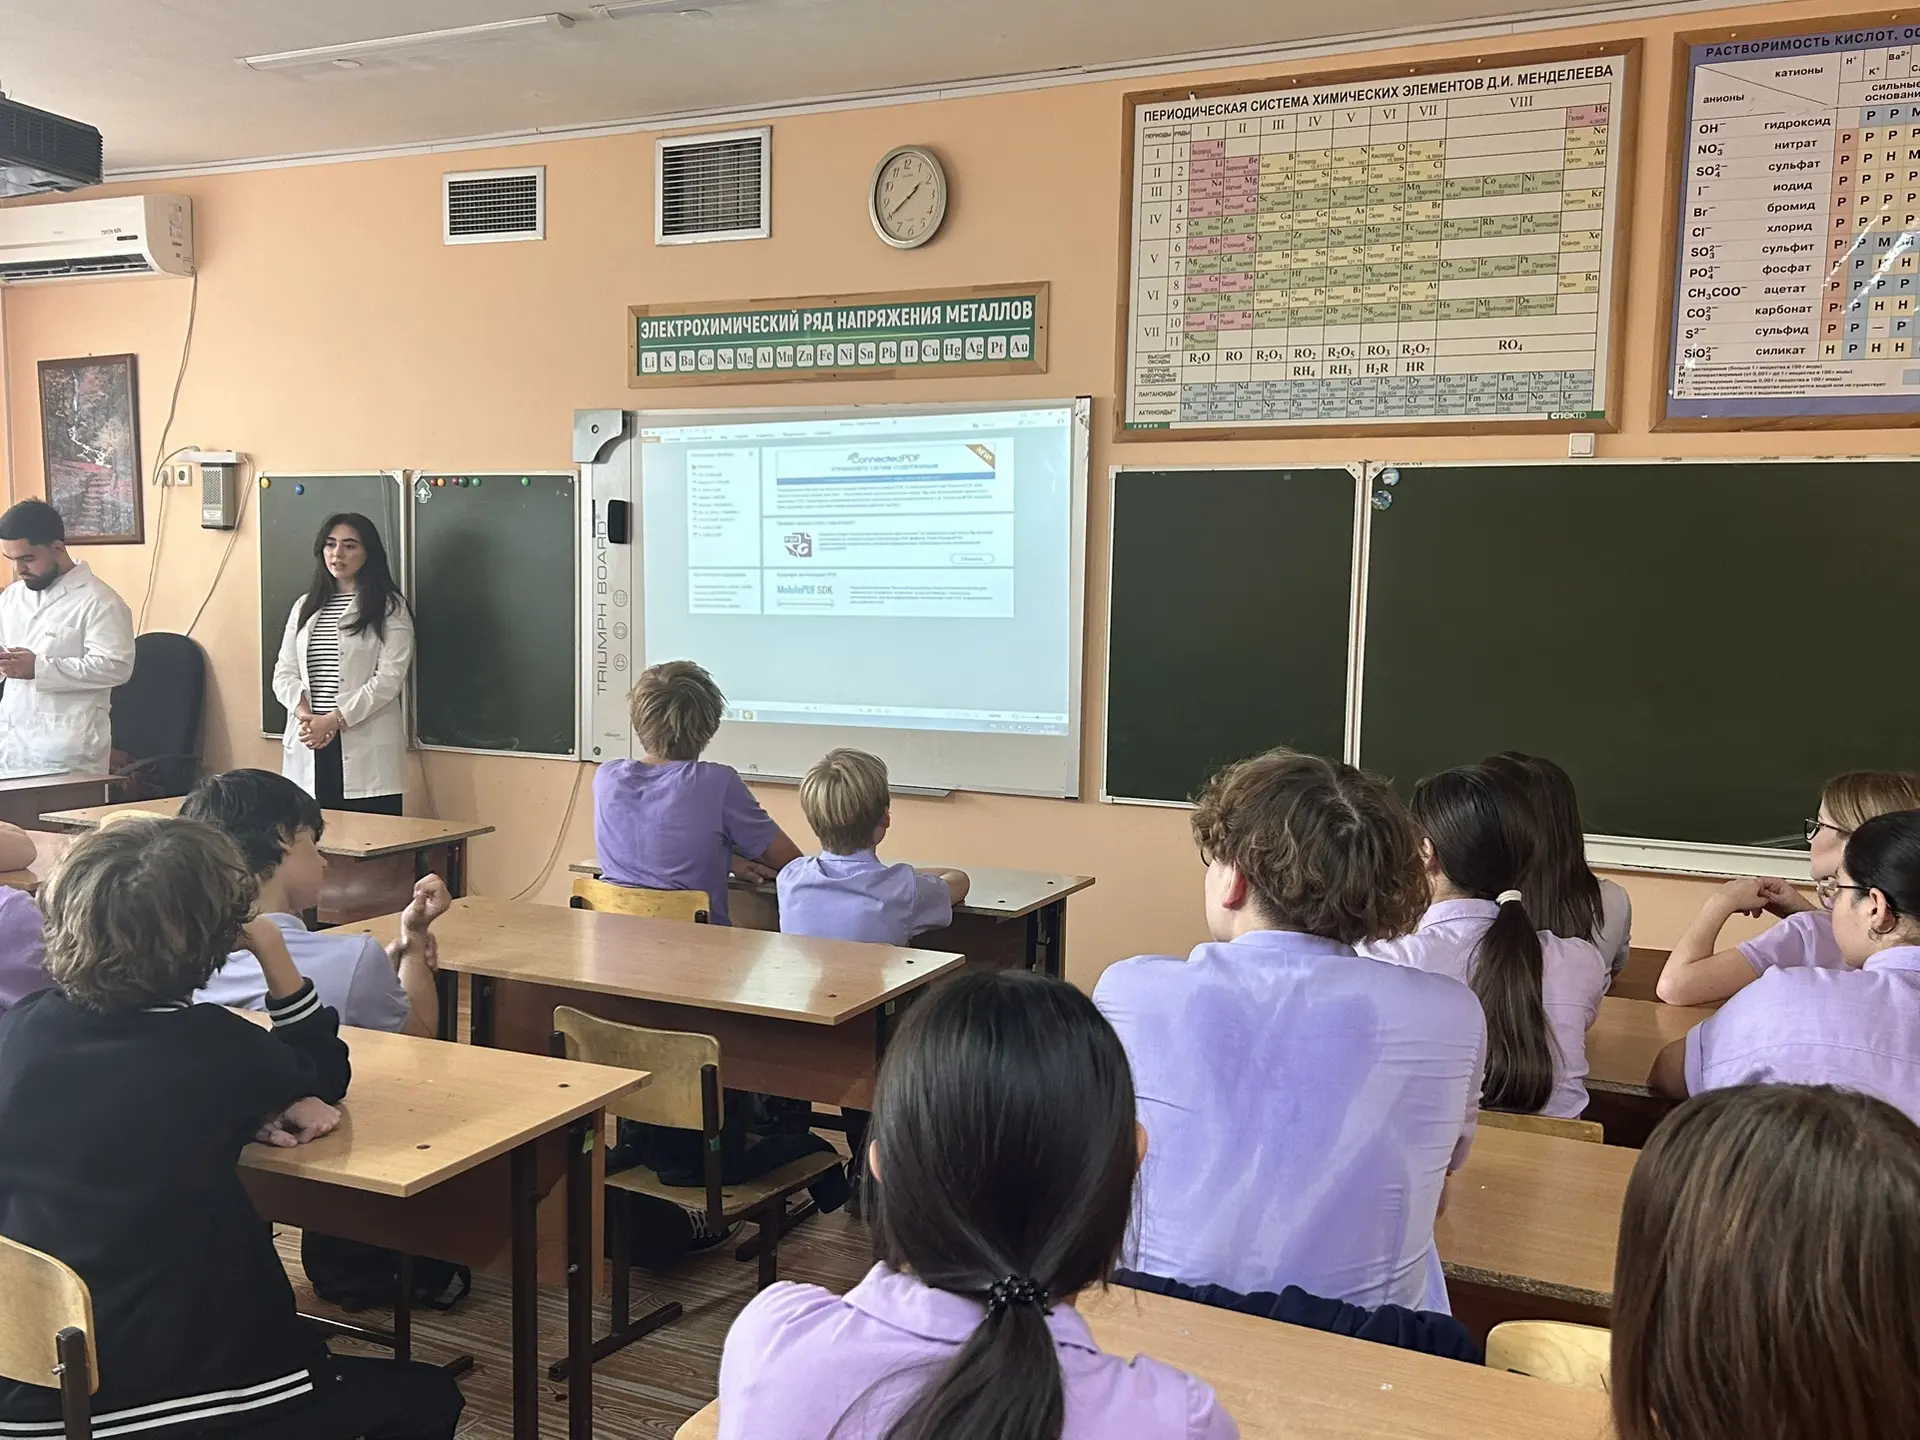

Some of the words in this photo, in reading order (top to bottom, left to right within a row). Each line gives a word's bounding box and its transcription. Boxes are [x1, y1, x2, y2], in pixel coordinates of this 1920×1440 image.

[1706, 37, 1830, 58] РАСТВОРИМОСТЬ
[1835, 29, 1897, 46] КИСЛОТ,
[1775, 66, 1823, 78] катионы
[1144, 101, 1247, 122] ПЕРИОДИЧЕСКАЯ
[1251, 95, 1309, 112] СИСТЕМА
[1312, 86, 1399, 106] ХИМИЧЕСКИХ
[1403, 77, 1484, 97] ЭЛЕМЕНТОВ
[1486, 75, 1513, 90] Д.И.
[1517, 64, 1613, 86] МЕНДЕЛЕЕВА
[1703, 93, 1744, 104] анионы
[1239, 123, 1247, 134] II
[1272, 120, 1285, 130] III
[1309, 116, 1322, 127] IV
[1347, 113, 1356, 123] V
[1383, 109, 1396, 119] VI
[1419, 105, 1437, 116] VII
[1509, 96, 1533, 108] VIII
[1764, 117, 1831, 132] гидроксид
[1774, 139, 1817, 150] нитрат
[1180, 147, 1183, 156] 1
[904, 159, 911, 170] 12
[918, 163, 922, 173] 1
[1768, 159, 1820, 173] сульфат
[892, 167, 899, 178] 11
[1154, 167, 1161, 177] II
[1177, 167, 1183, 176] 2
[926, 174, 932, 185] 2
[885, 182, 893, 192] 10
[1151, 186, 1162, 196] III
[1177, 185, 1183, 195] 3
[1773, 180, 1812, 193] иодид
[931, 190, 935, 199] 3
[884, 198, 890, 209] 9
[1767, 200, 1815, 213] бромид
[927, 205, 933, 215] 4
[1176, 204, 1182, 214] 4
[920, 218, 925, 228] 5
[1150, 214, 1162, 224] IV
[897, 222, 903, 232] 7
[908, 225, 914, 236] 6
[1175, 223, 1181, 233] 5
[1767, 223, 1812, 234] хлорид
[1174, 243, 1181, 252] 6
[1762, 242, 1814, 255] сульфит
[1150, 254, 1159, 263] V
[1174, 262, 1180, 271] 7
[1762, 263, 1811, 276] фосфат
[1173, 281, 1179, 290] 8
[1764, 284, 1806, 296] ацетат
[1147, 291, 1159, 300] VI
[1172, 300, 1179, 309] 9
[1755, 304, 1812, 317] карбонат
[641, 309, 800, 340] ЭЛЕКТРОХИМИЧЕСКИЙ
[803, 312, 835, 333] РЯД
[838, 305, 942, 330] НАПРЯЖЕНИЯ
[945, 300, 1033, 325] МЕТАЛЛОВ
[1170, 318, 1181, 328] 10
[1144, 327, 1159, 337] VII
[1755, 325, 1809, 337] сульфид
[1170, 337, 1179, 346] 11
[644, 356, 655, 368] Li
[664, 355, 672, 367] K
[681, 354, 694, 367] Ba
[699, 353, 713, 366] Ca
[719, 353, 732, 366] Na
[738, 352, 753, 369] Mg
[759, 351, 771, 364] Al
[778, 350, 793, 363] Mn
[798, 349, 812, 362] Zn
[820, 349, 832, 361] Fe
[840, 348, 853, 361] Ni
[860, 347, 874, 360] Sn
[882, 346, 896, 360] Pb
[905, 345, 914, 358] H
[923, 344, 939, 358] Cu
[945, 343, 961, 359] Hg
[967, 342, 983, 358] Ag
[990, 341, 1003, 354] Pt
[1012, 340, 1028, 354] Au
[1226, 351, 1243, 361] RO
[1755, 346, 1805, 356] силикат
[1406, 362, 1425, 372] HR
[598, 520, 607, 595] BOARD
[817, 585, 833, 594] SDK
[597, 604, 608, 696] TRIUMPH
